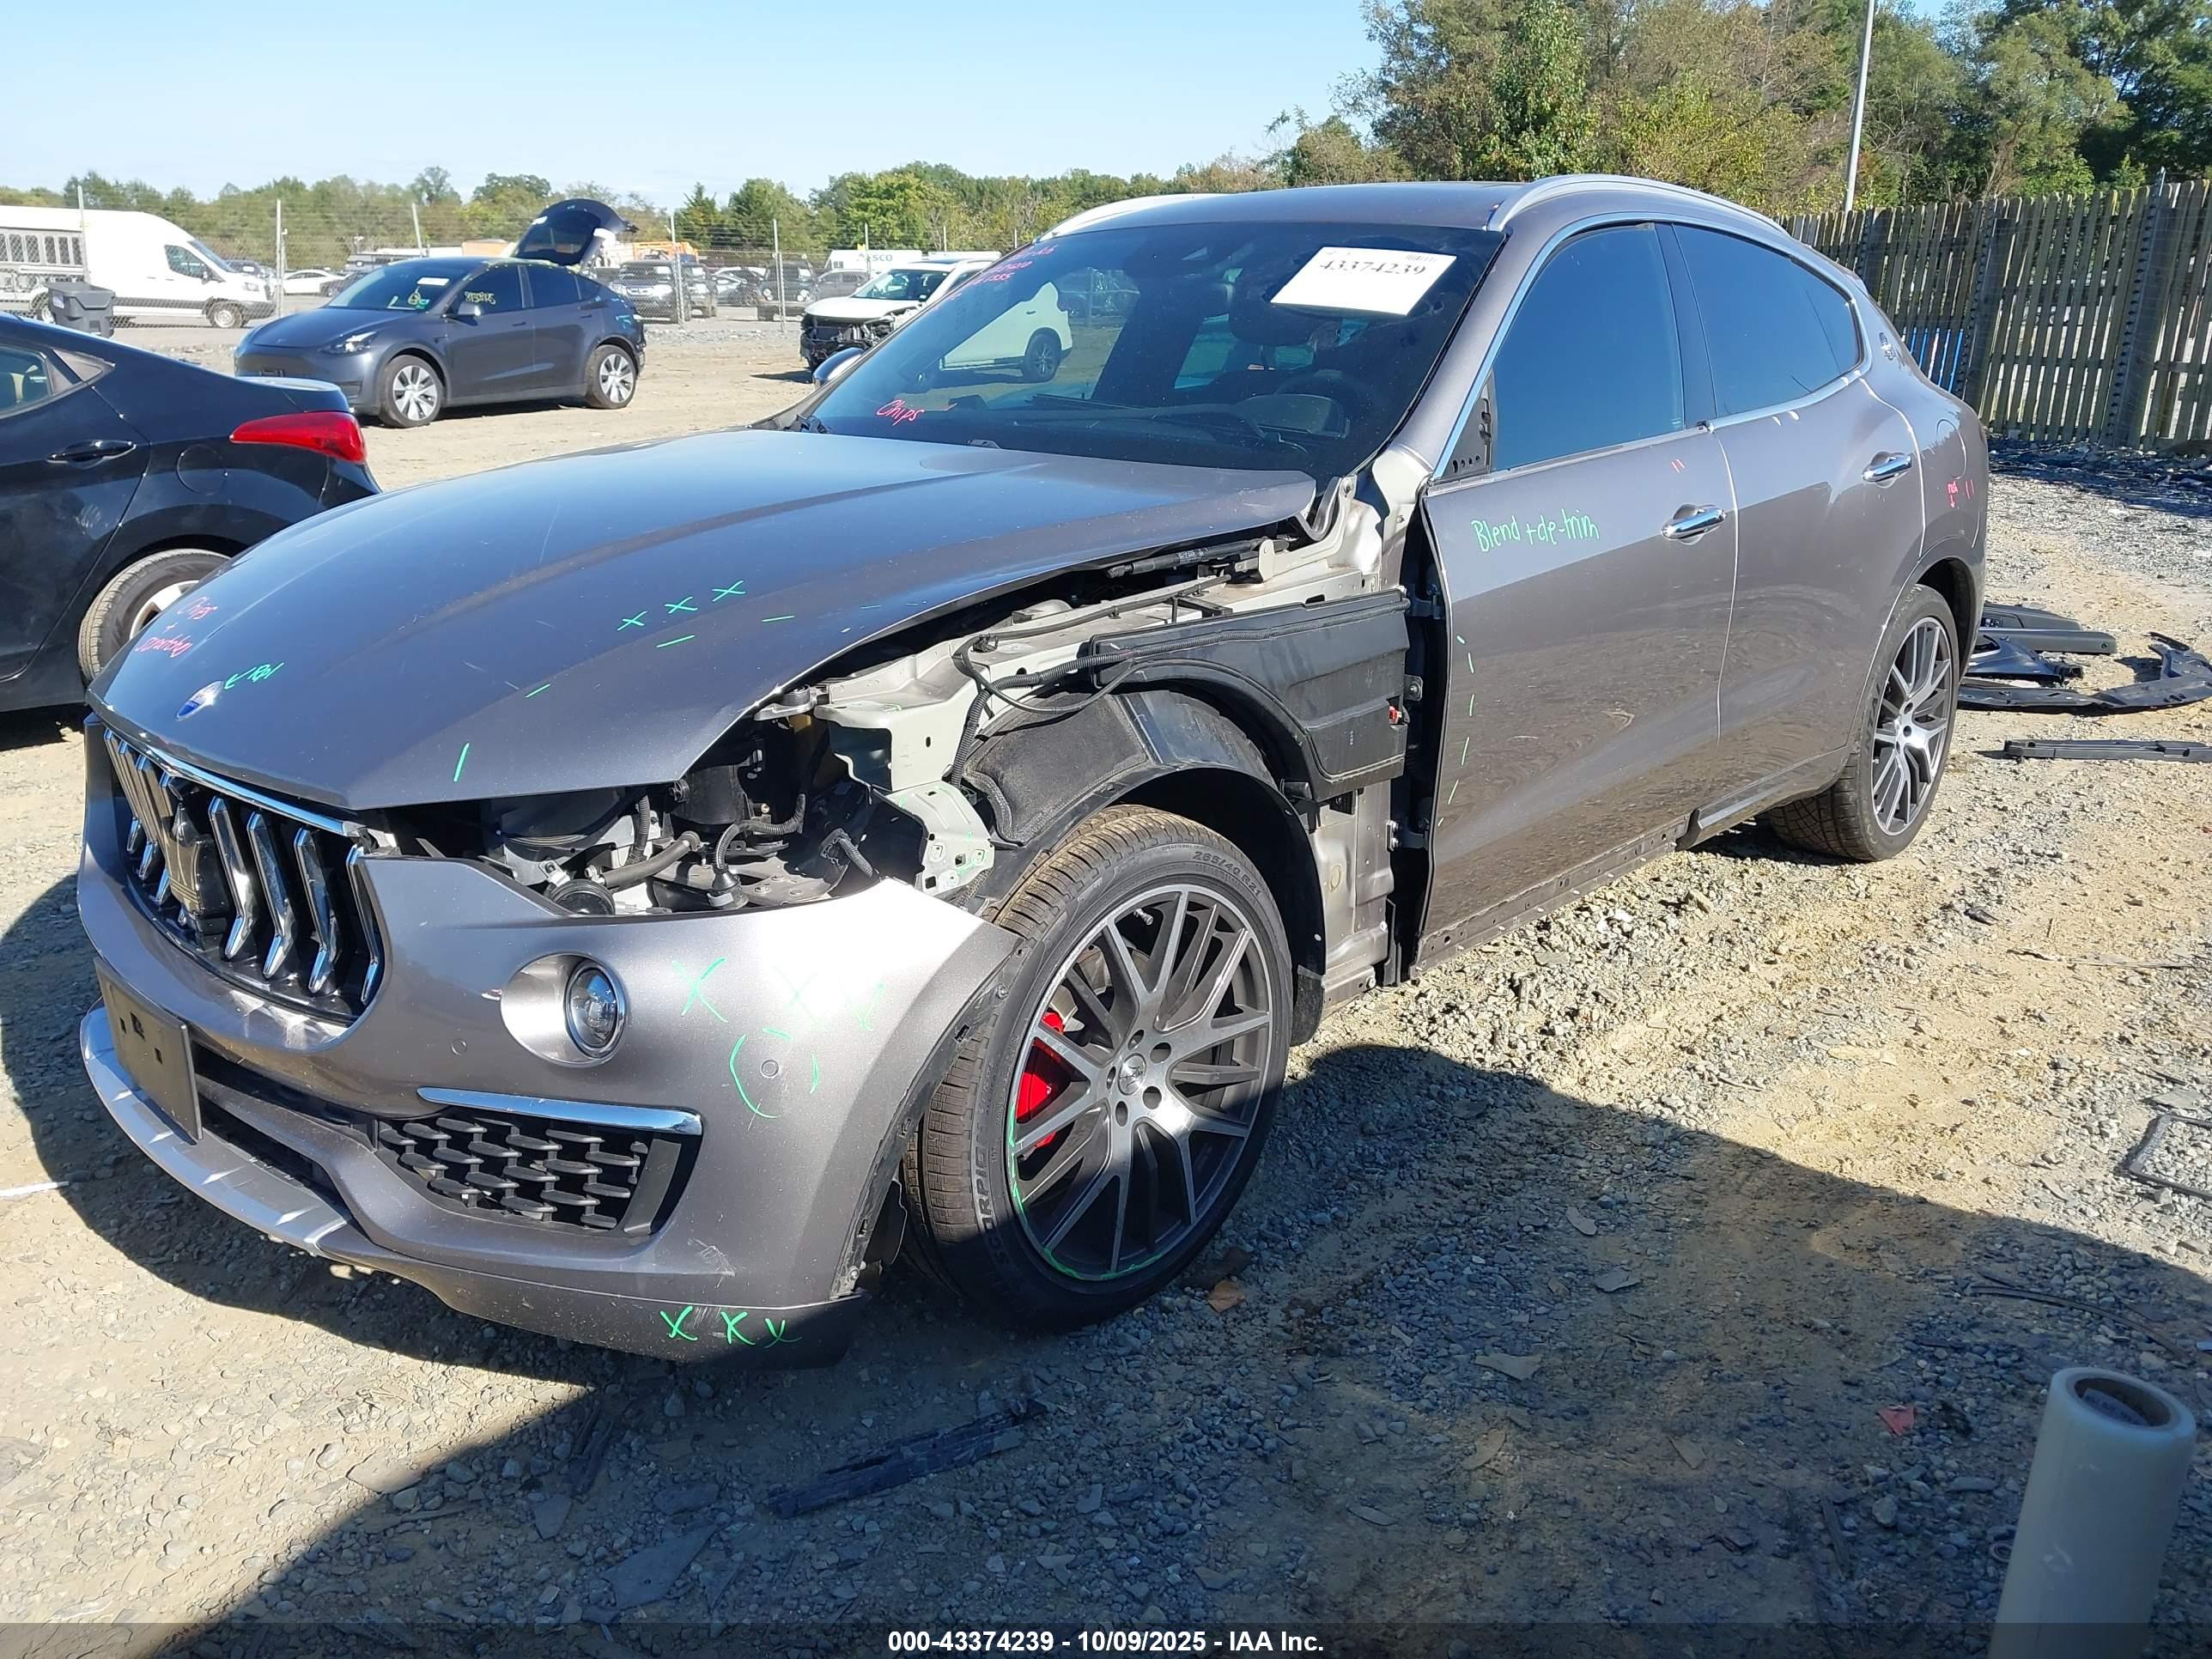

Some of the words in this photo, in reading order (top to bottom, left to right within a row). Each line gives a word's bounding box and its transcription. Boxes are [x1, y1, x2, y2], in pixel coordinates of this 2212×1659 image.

[1319, 260, 1426, 275] 43374239
[1471, 515, 1522, 552] Blend
[1192, 850, 1241, 875] 265/40
